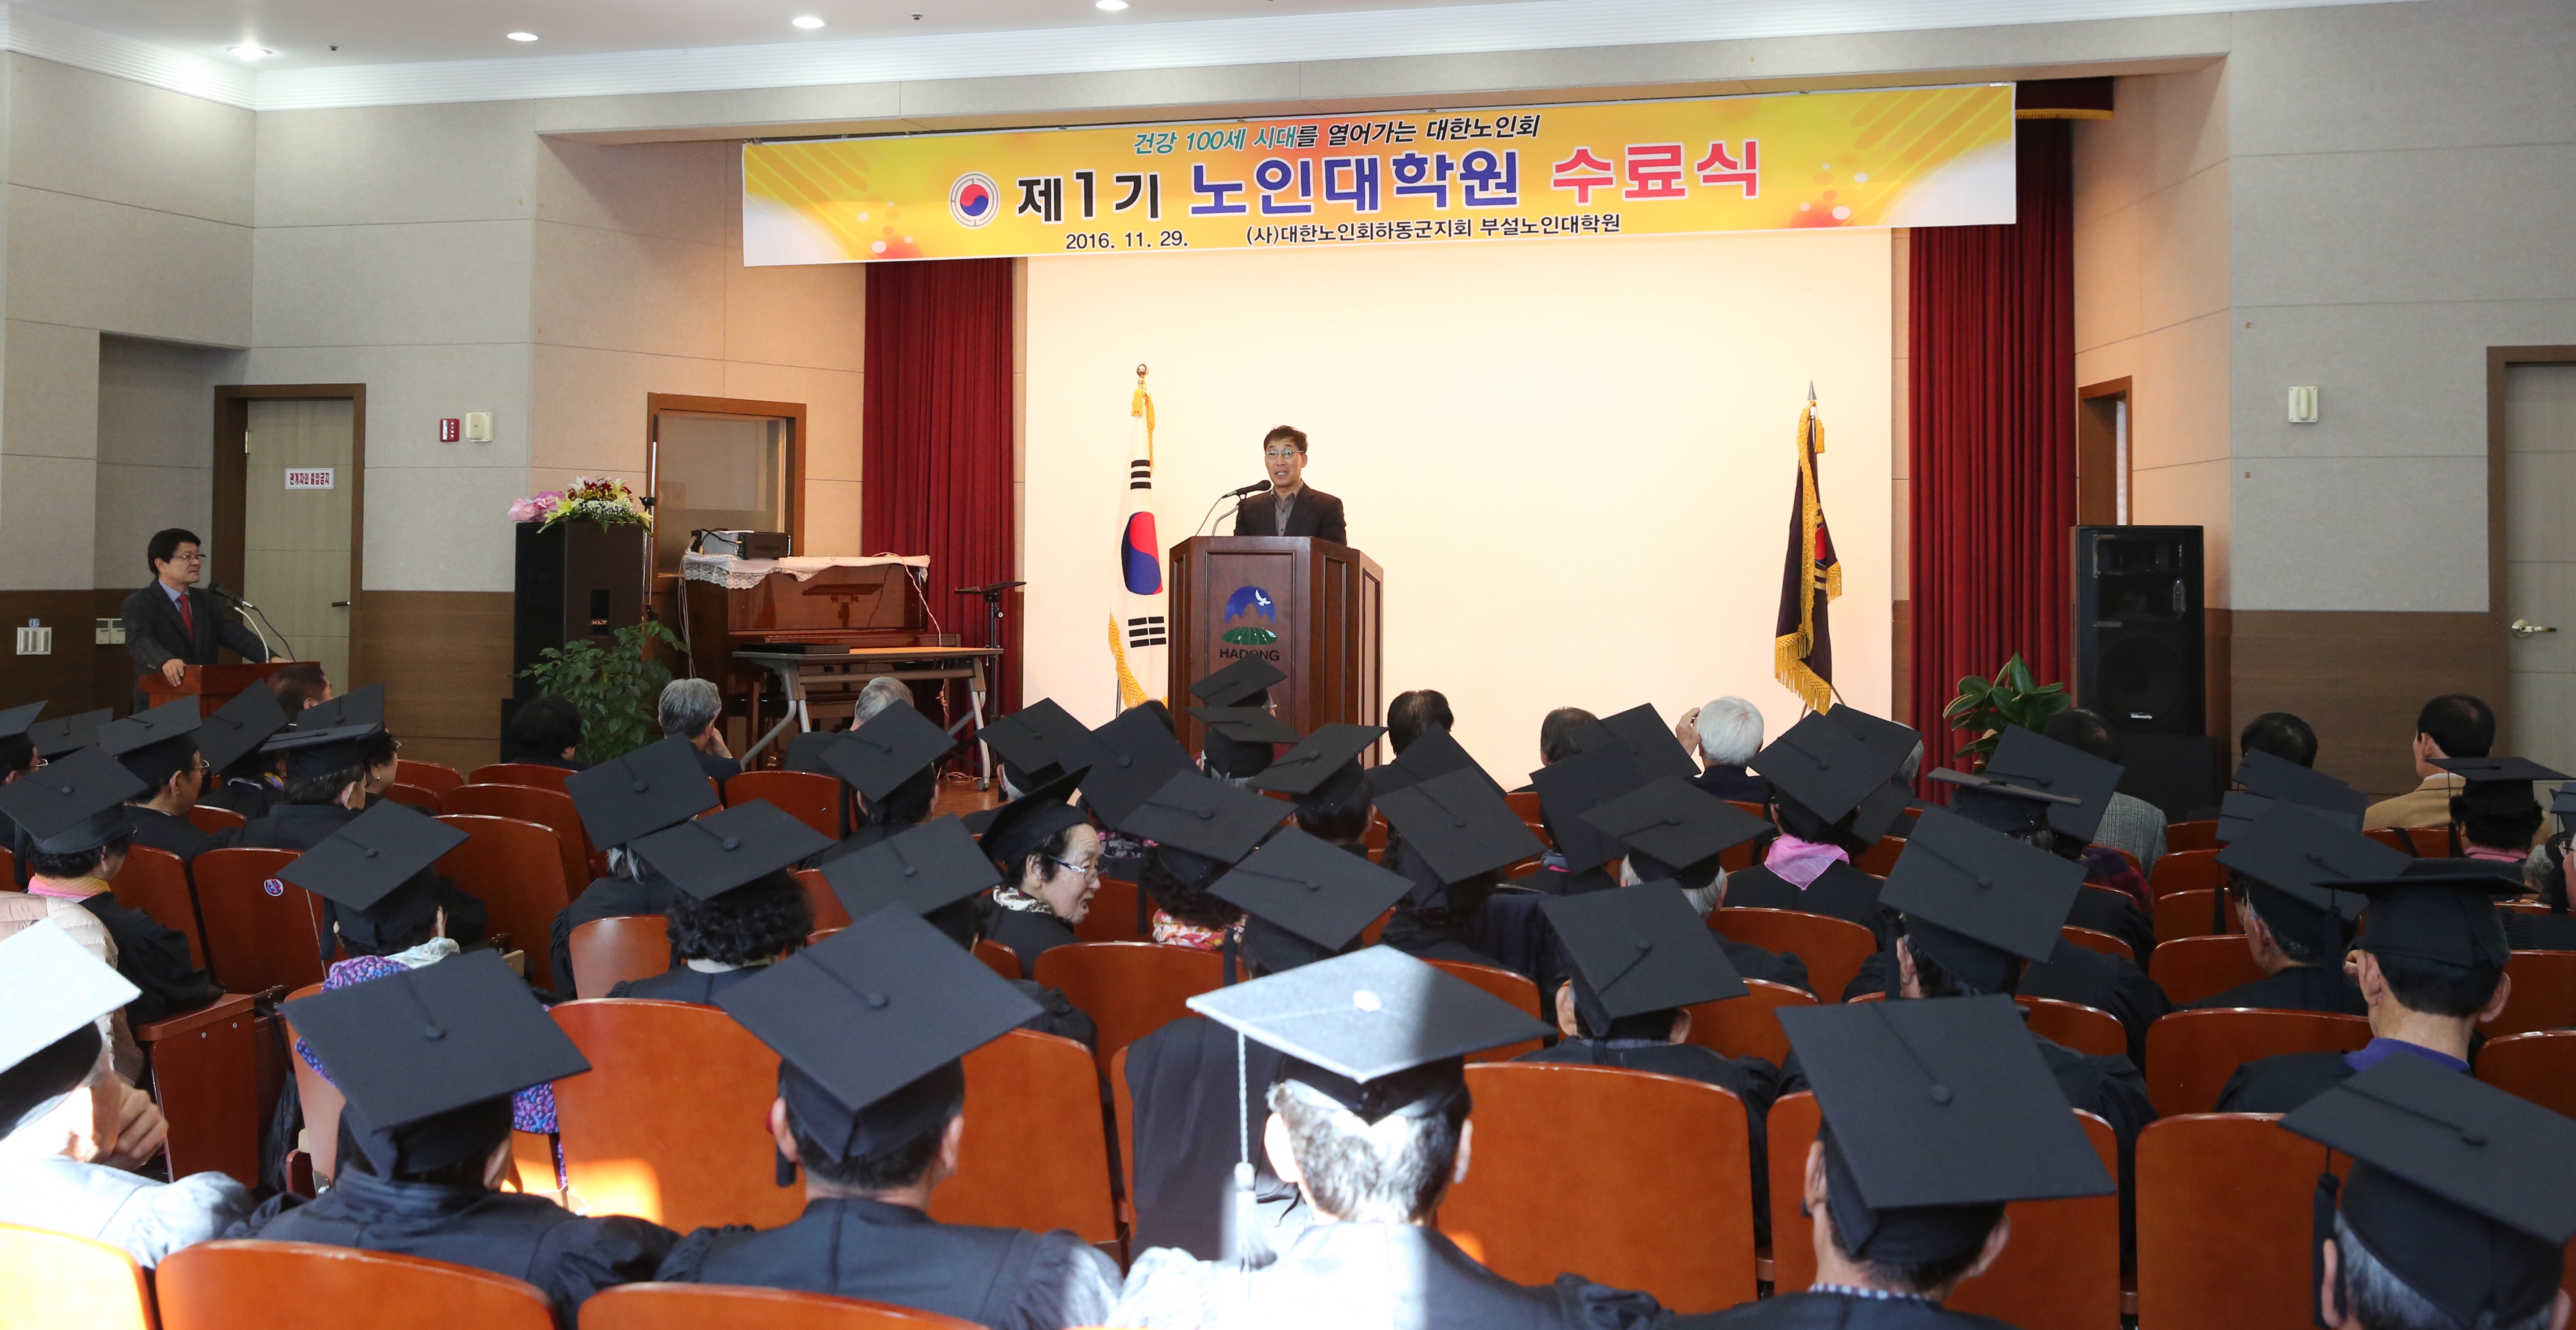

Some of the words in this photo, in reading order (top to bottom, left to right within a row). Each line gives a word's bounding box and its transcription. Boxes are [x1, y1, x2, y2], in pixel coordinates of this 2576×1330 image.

[1134, 132, 1177, 154] 건강
[1186, 128, 1246, 151] 100세
[1253, 125, 1318, 149] 시대를
[1328, 121, 1416, 146] 열어가는
[1426, 114, 1541, 141] 대한노인회
[1191, 151, 1517, 214] 노인대학원
[1553, 141, 1757, 203] 수료식
[1066, 233, 1115, 249] 2016.
[1125, 232, 1151, 247] 11.
[1160, 231, 1188, 246] 29.
[1246, 219, 1472, 245] (사)대한노인회하동군지회
[1480, 214, 1620, 236] 부설노인대학원
[311, 472, 329, 485] 출입금지
